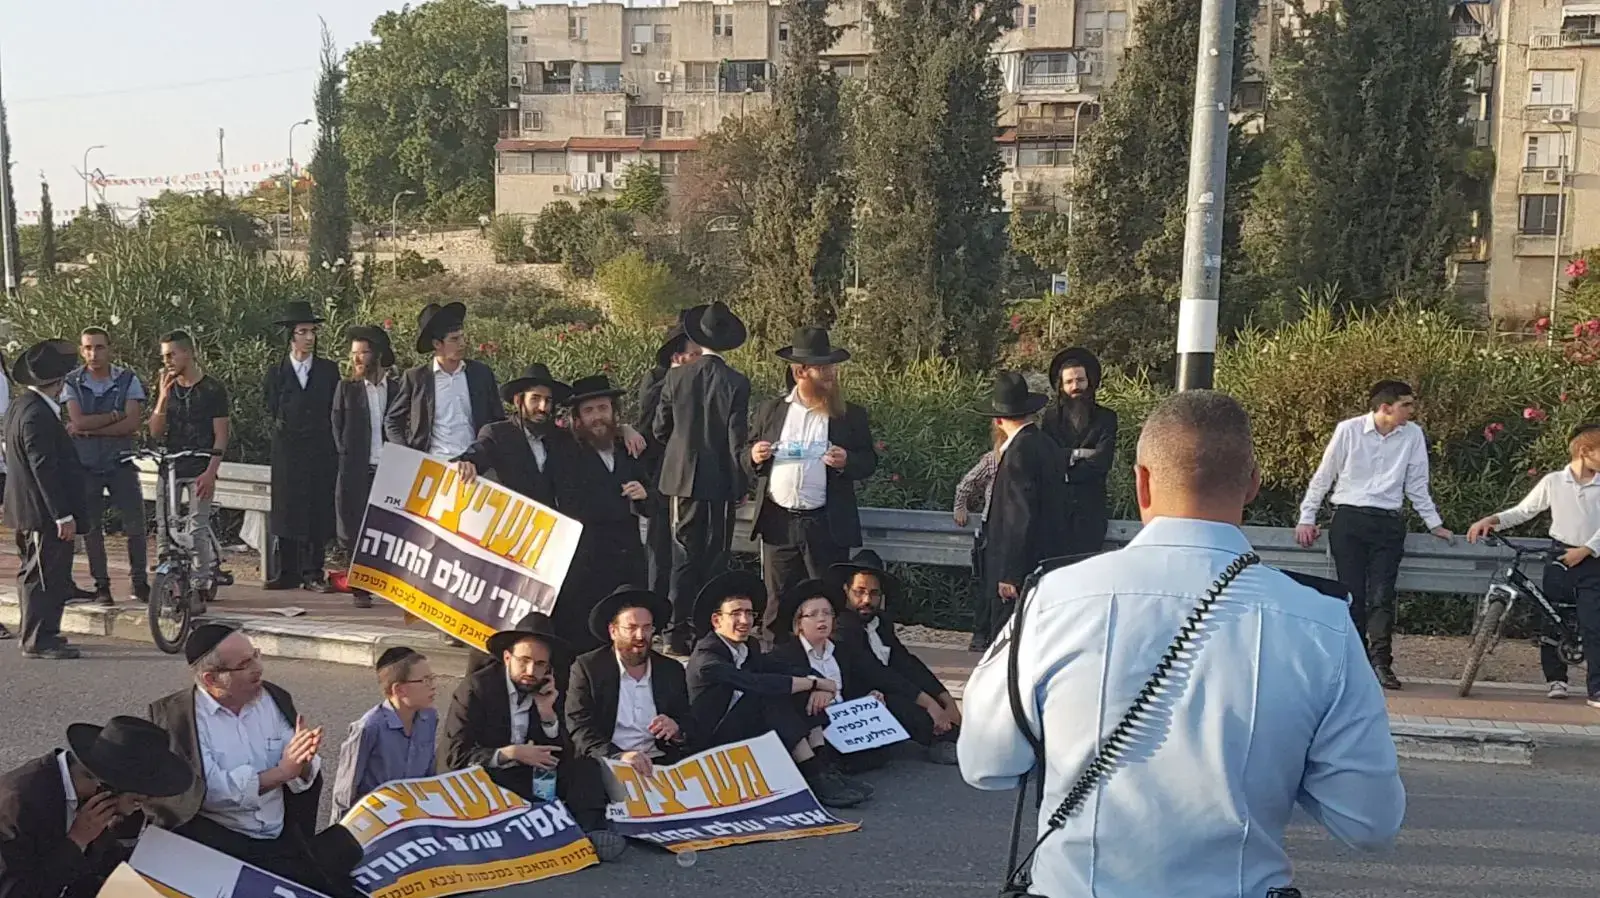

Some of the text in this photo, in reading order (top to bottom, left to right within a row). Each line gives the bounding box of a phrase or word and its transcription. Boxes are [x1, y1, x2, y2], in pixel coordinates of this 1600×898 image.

[384, 495, 402, 506] את
[352, 570, 388, 591] השמד
[361, 527, 553, 626] סירי עולם התורה
[390, 584, 417, 605] לצבא
[850, 701, 880, 716] עמלק
[837, 719, 869, 733] לכפיה
[610, 807, 625, 816] את
[762, 809, 833, 827] אסירי
[700, 819, 766, 836] עולם
[349, 836, 448, 885] התורה
[515, 858, 559, 879] המאבק
